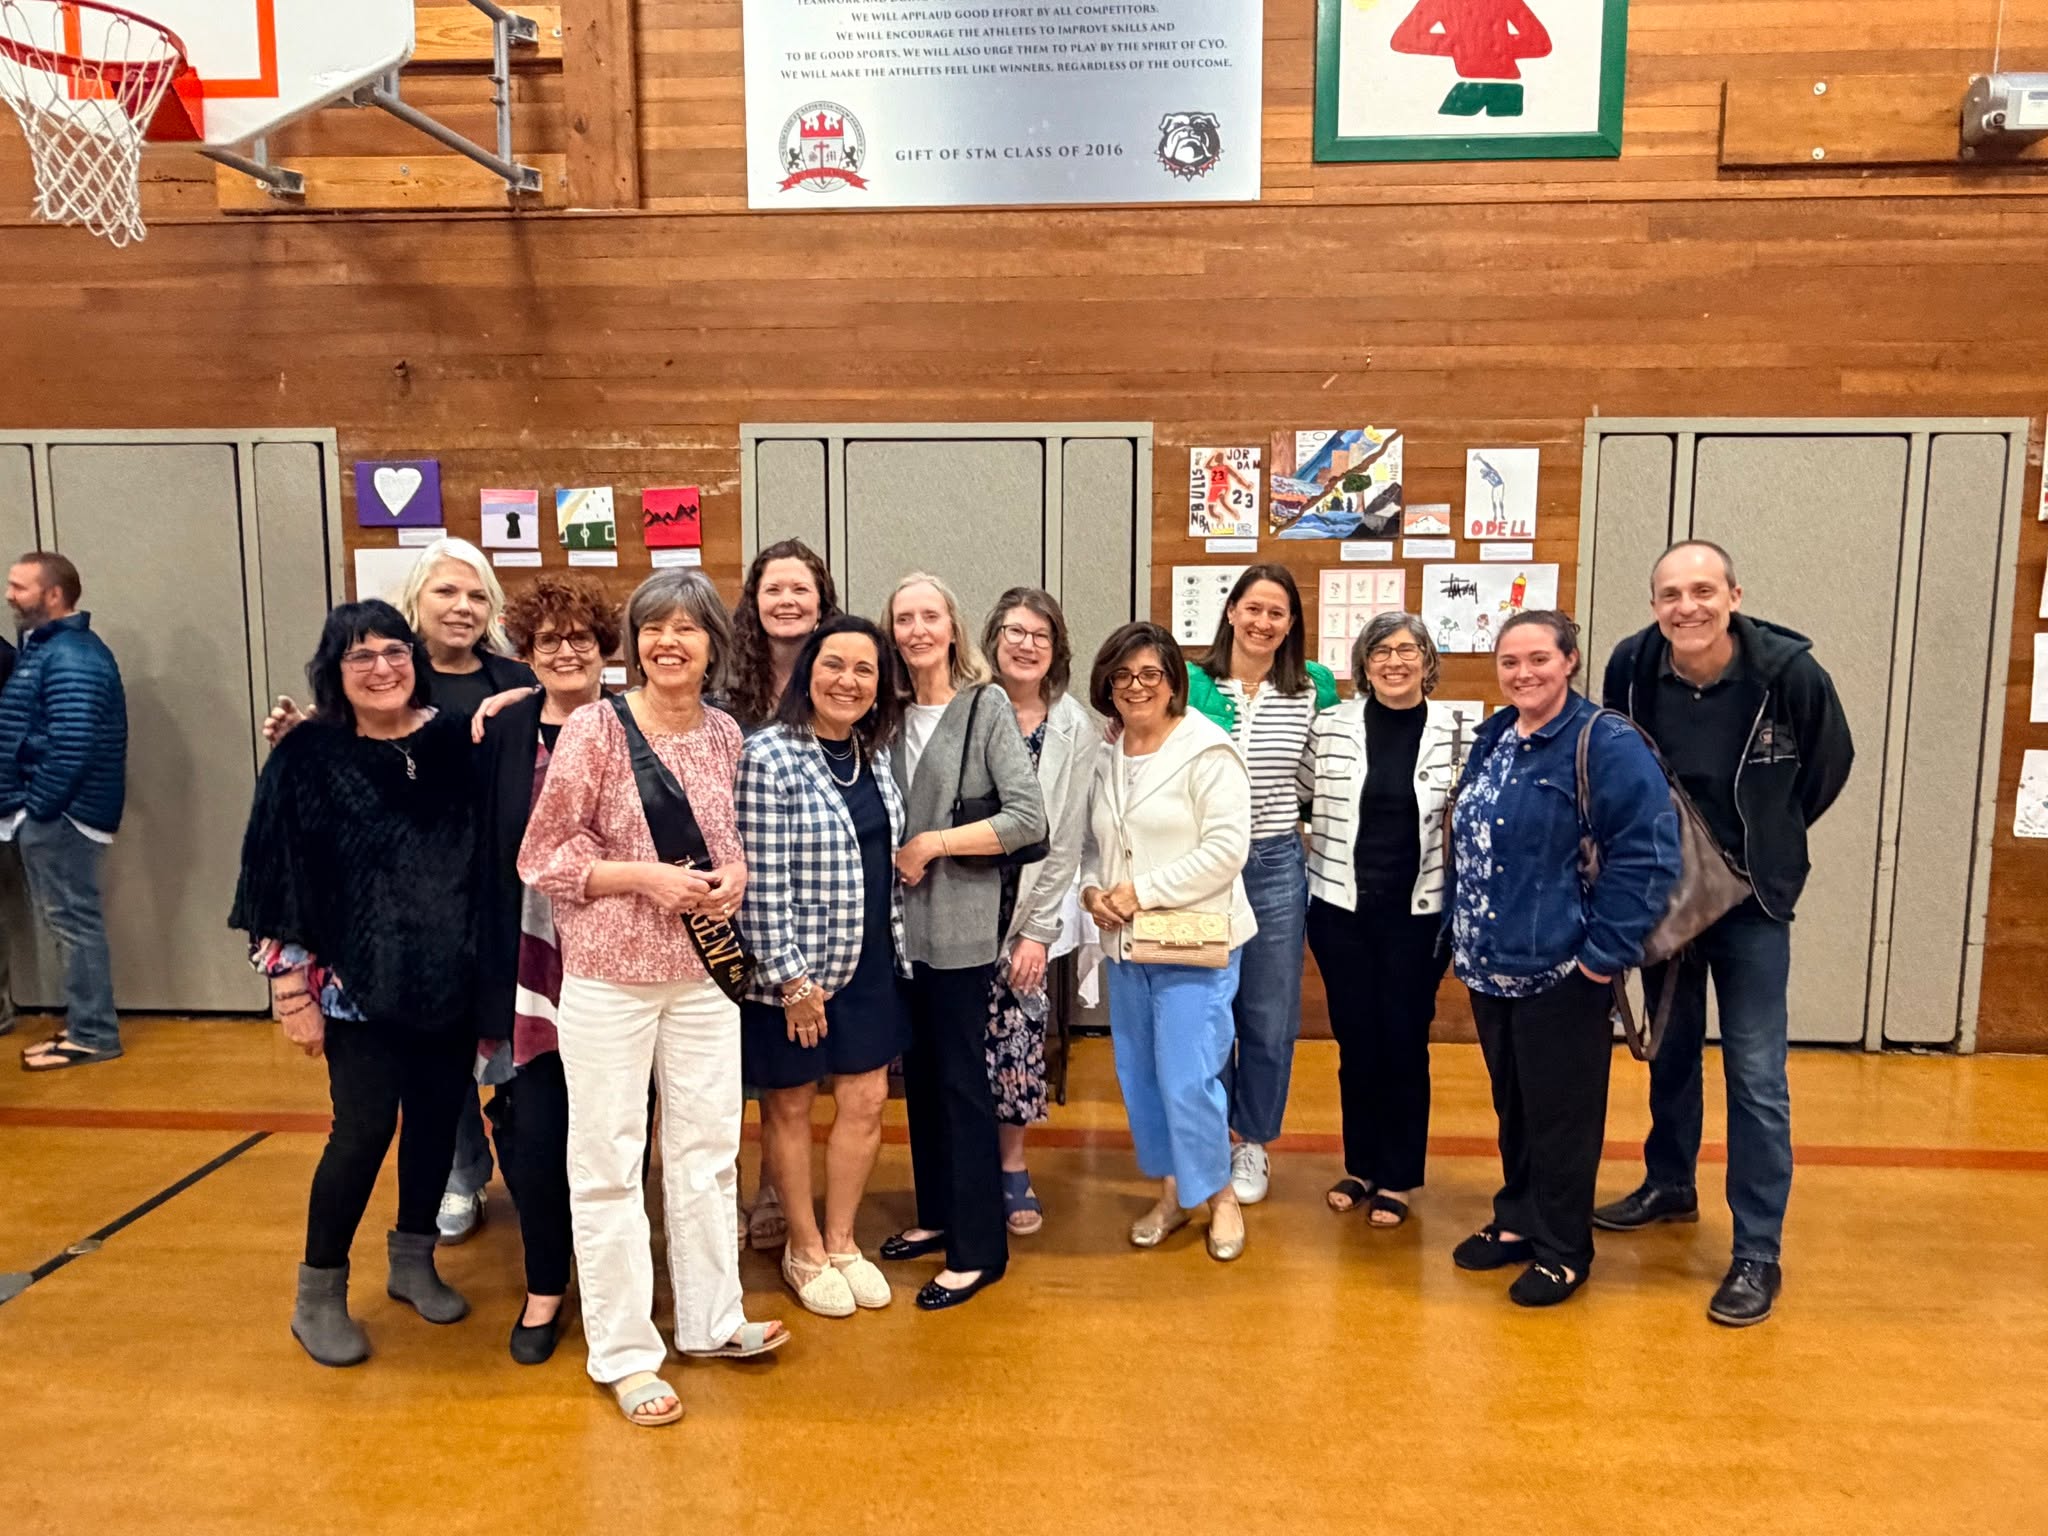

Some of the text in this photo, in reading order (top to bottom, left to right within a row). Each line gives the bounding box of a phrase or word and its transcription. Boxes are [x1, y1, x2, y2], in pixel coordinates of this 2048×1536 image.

[852, 13, 867, 21] WE
[872, 12, 897, 21] WILL
[955, 9, 989, 18] GOOD
[1037, 8, 1050, 16] BY
[1053, 7, 1072, 15] ALL
[836, 32, 851, 40] WE
[959, 28, 979, 37] THE
[1040, 26, 1054, 34] TO
[1151, 23, 1175, 31] AND
[805, 52, 816, 60] BE
[820, 51, 854, 59] GOOD
[903, 48, 920, 56] WE
[923, 48, 950, 56] WILL
[953, 47, 980, 56] ALSO
[984, 46, 1013, 55] URGE
[1017, 45, 1048, 54] THEM
[1053, 44, 1067, 53] TO
[1071, 44, 1097, 52] PLAY
[1101, 43, 1113, 51] BY
[1117, 42, 1138, 51] THE
[1181, 41, 1195, 49] OF
[1199, 39, 1227, 48] CYO.
[781, 71, 798, 79] WE
[801, 70, 827, 78] WILL
[831, 69, 860, 77] MAKE
[864, 68, 885, 76] THE
[945, 66, 968, 74] FEEL
[972, 65, 997, 74] LIKE
[1130, 61, 1144, 69] OF
[1148, 60, 1168, 68] THE
[896, 144, 1123, 160] GIFT OF STM CLASS OF 2016
[1211, 470, 1224, 481] 23
[1190, 469, 1206, 511] BULLS
[1232, 489, 1254, 508] 23
[1471, 520, 1532, 536] ODELL
